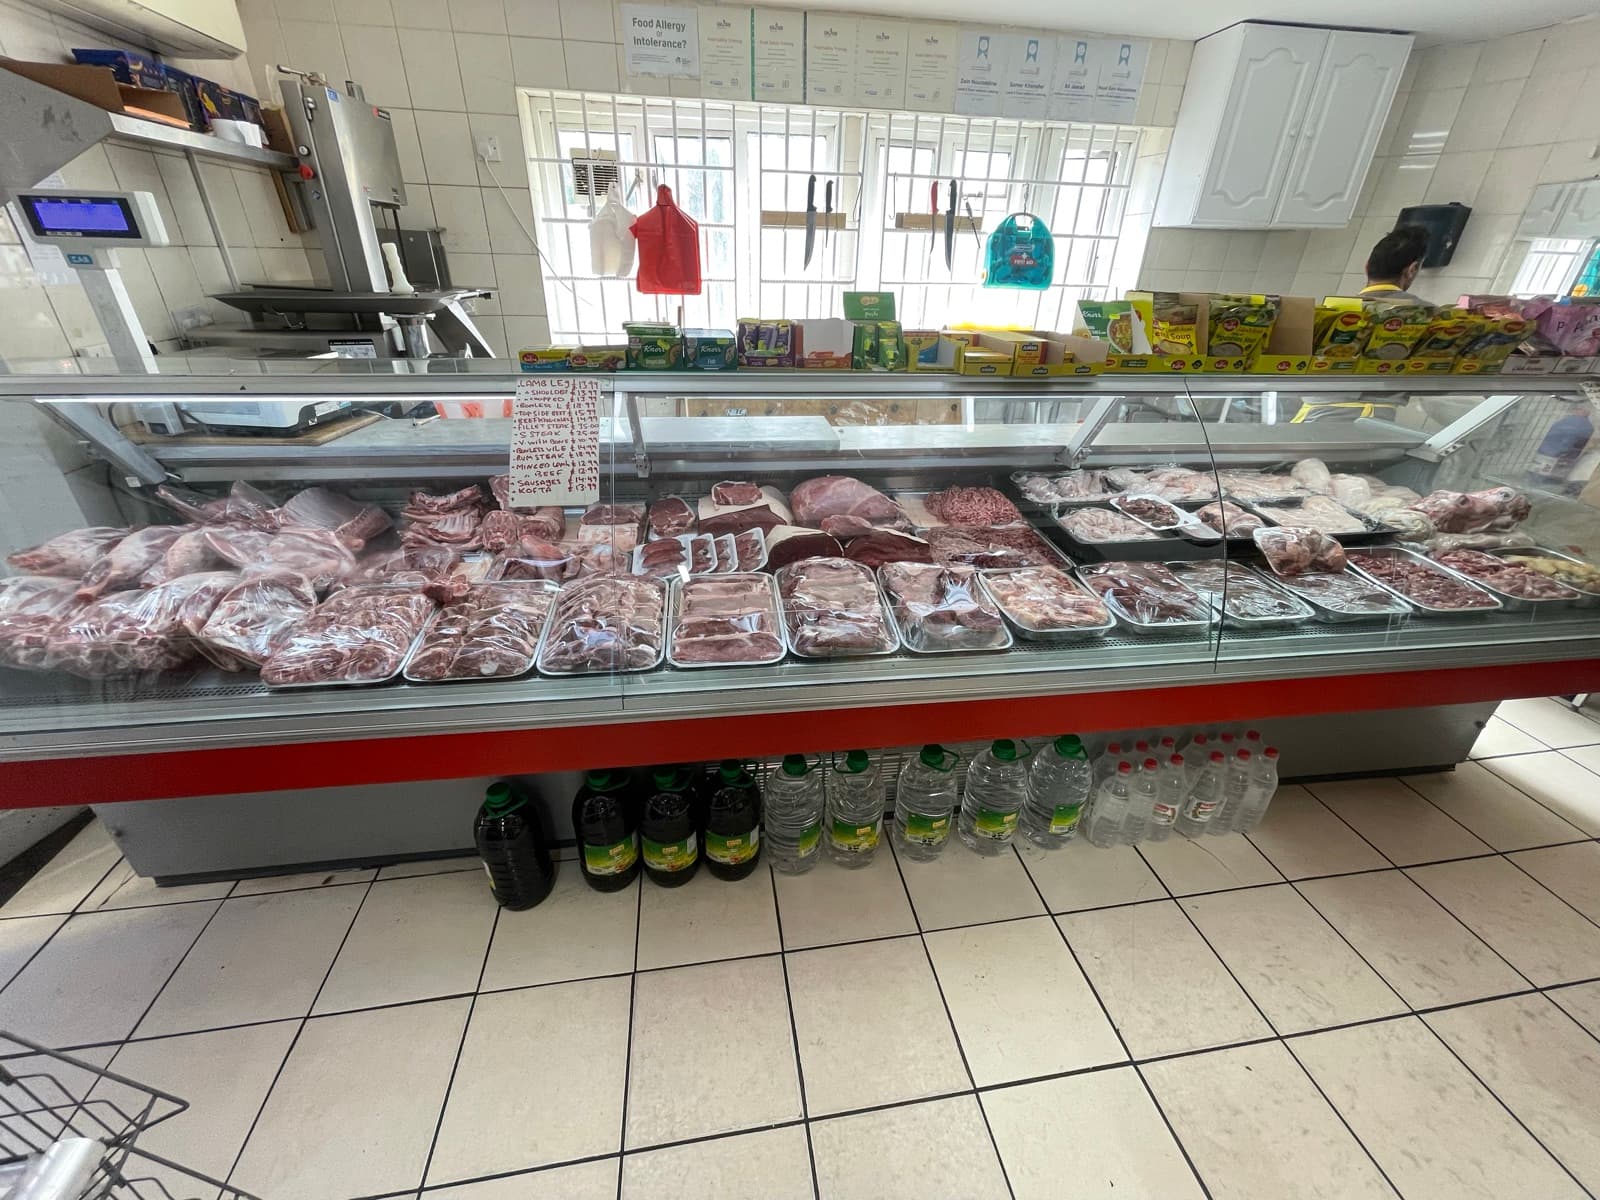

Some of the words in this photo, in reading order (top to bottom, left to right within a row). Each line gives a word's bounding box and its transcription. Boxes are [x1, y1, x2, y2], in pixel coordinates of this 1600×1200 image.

[632, 17, 654, 28] Food
[656, 19, 686, 32] Allergy
[633, 36, 687, 48] Intolerance?
[643, 345, 665, 353] Knorr
[700, 345, 722, 353] Knorr
[535, 469, 563, 478] BEEF
